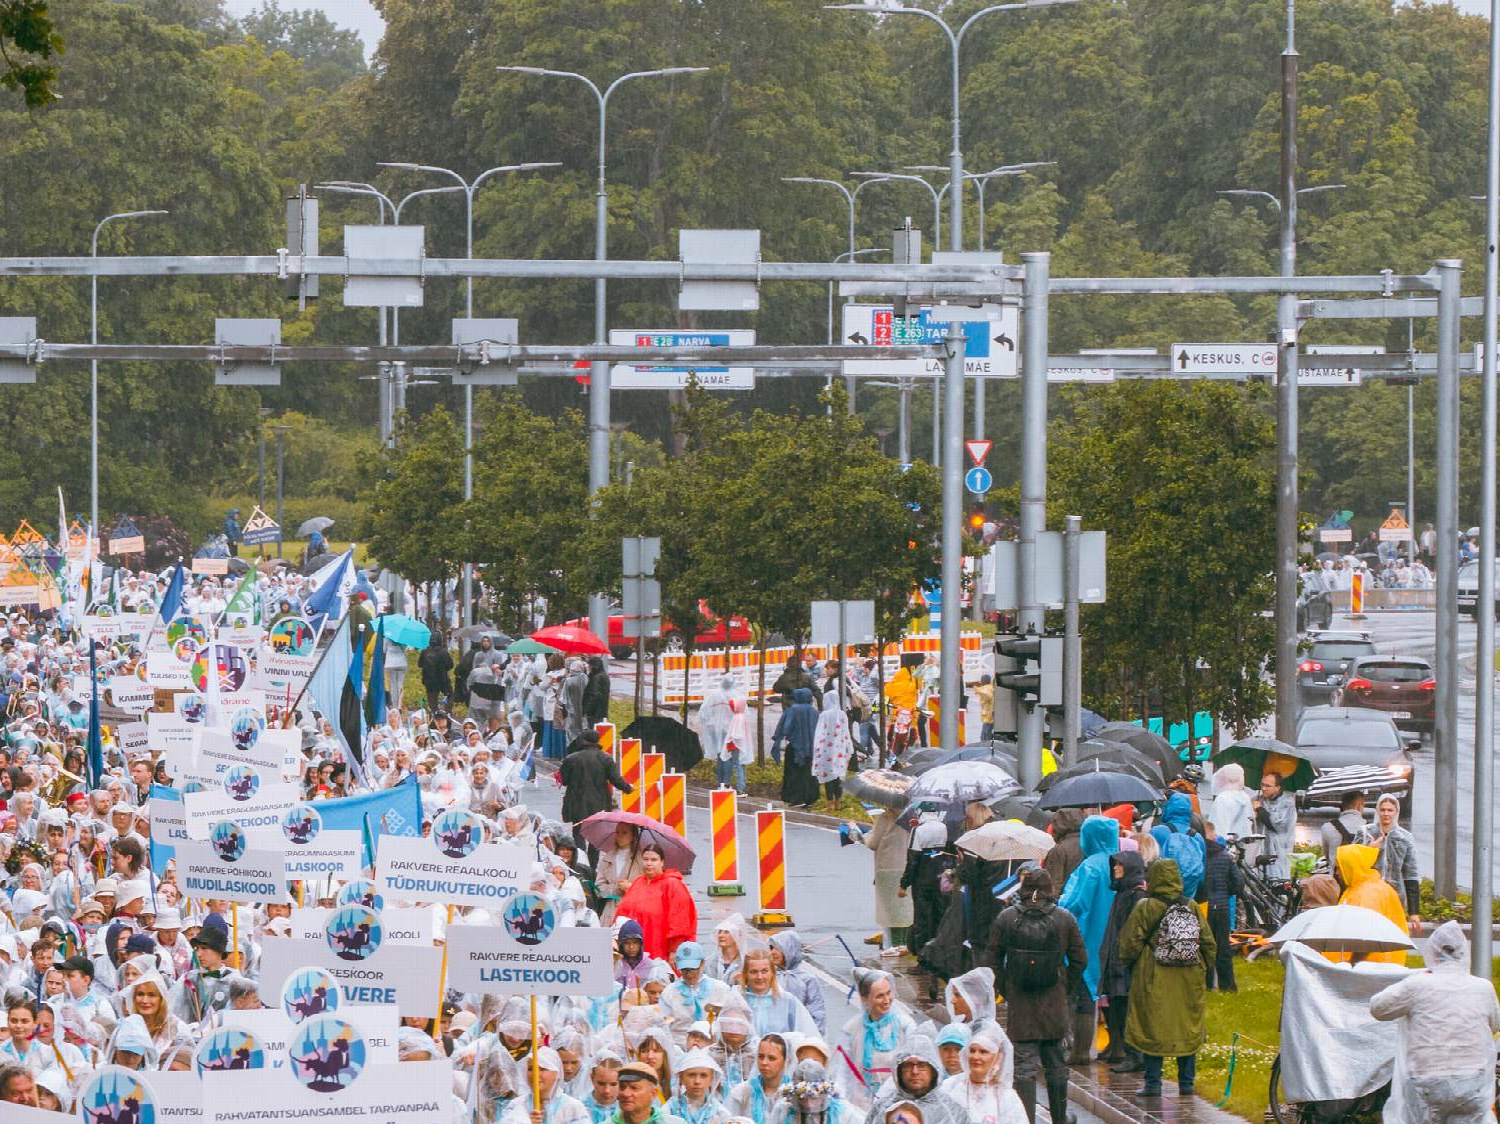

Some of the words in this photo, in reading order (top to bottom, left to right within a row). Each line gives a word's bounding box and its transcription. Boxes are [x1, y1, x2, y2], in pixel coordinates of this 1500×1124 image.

[881, 314, 886, 323] 1
[880, 328, 886, 337] 2
[904, 328, 922, 337] 263
[678, 337, 711, 346] NARVA
[1193, 353, 1245, 366] KESKUS,
[191, 808, 226, 818] RAKVERE
[168, 828, 192, 841] LAS
[189, 865, 231, 876] RAKVERE
[285, 862, 344, 872] ILASKOOR
[390, 860, 443, 874] RAKVERE
[445, 865, 517, 880] REAALKOOLI
[186, 877, 276, 896] MUDILASKOOR
[385, 873, 519, 898] TÜDRUKUTEKOOR
[388, 931, 421, 939] KOOLI
[469, 951, 520, 962] RAKVERE
[522, 953, 591, 964] REAALKOOLI
[329, 968, 384, 981] EESKOOR
[480, 967, 581, 984] LASTEKOOR
[341, 986, 397, 1004] VERE
[214, 1105, 367, 1123] RAHVATANTSUANSAMBEL
[369, 1101, 440, 1115] TARVANPÄÄ
